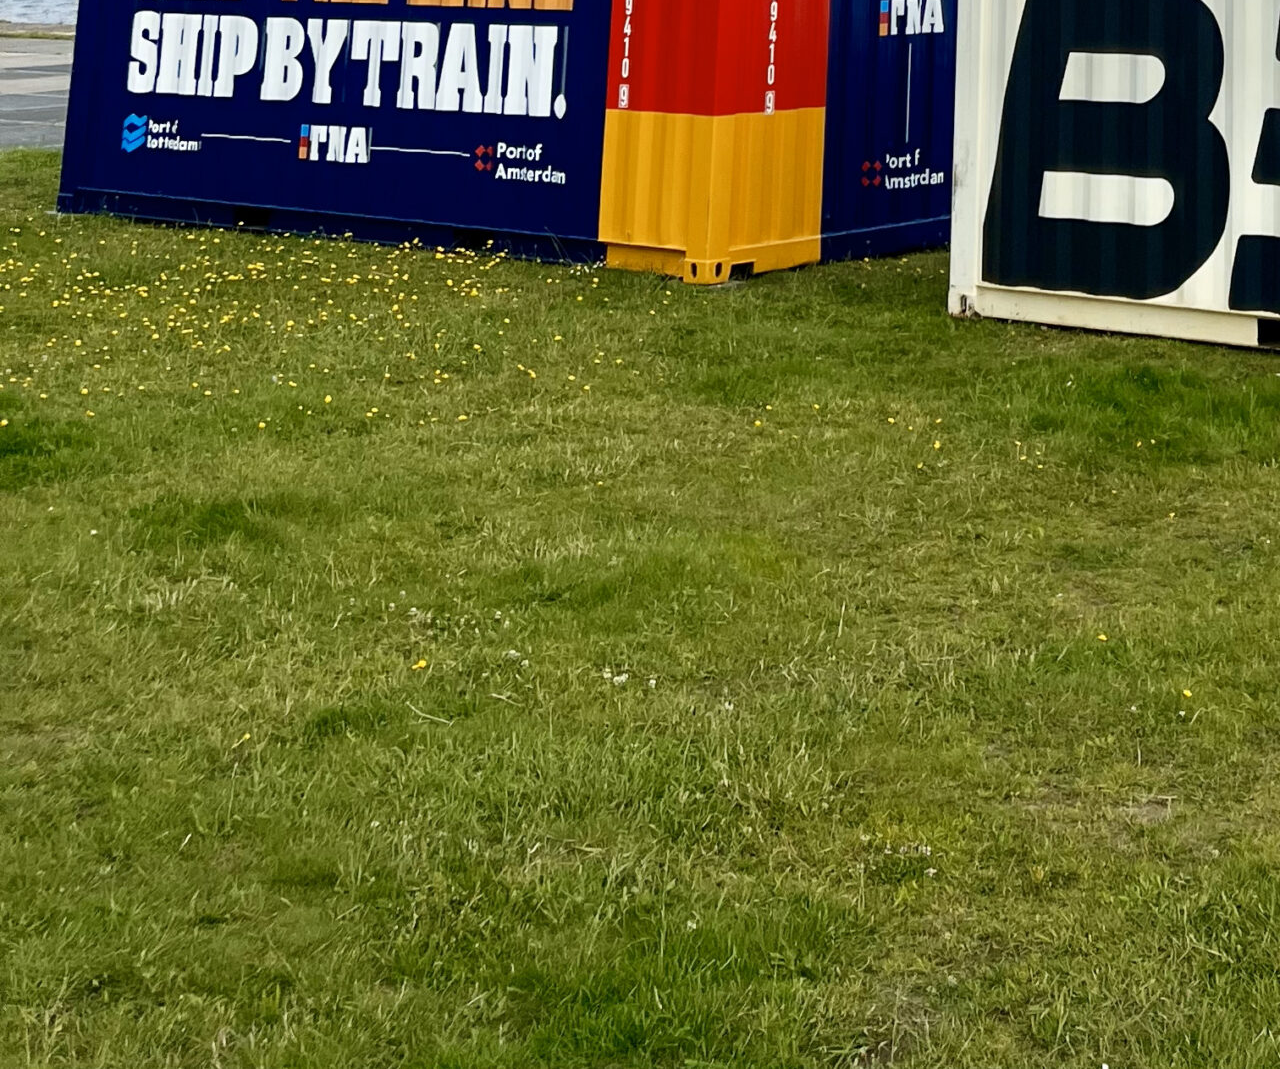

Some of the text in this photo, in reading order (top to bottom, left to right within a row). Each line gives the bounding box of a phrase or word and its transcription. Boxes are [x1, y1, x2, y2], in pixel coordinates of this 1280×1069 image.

[127, 10, 567, 120] SHIP BY TRAIN.
